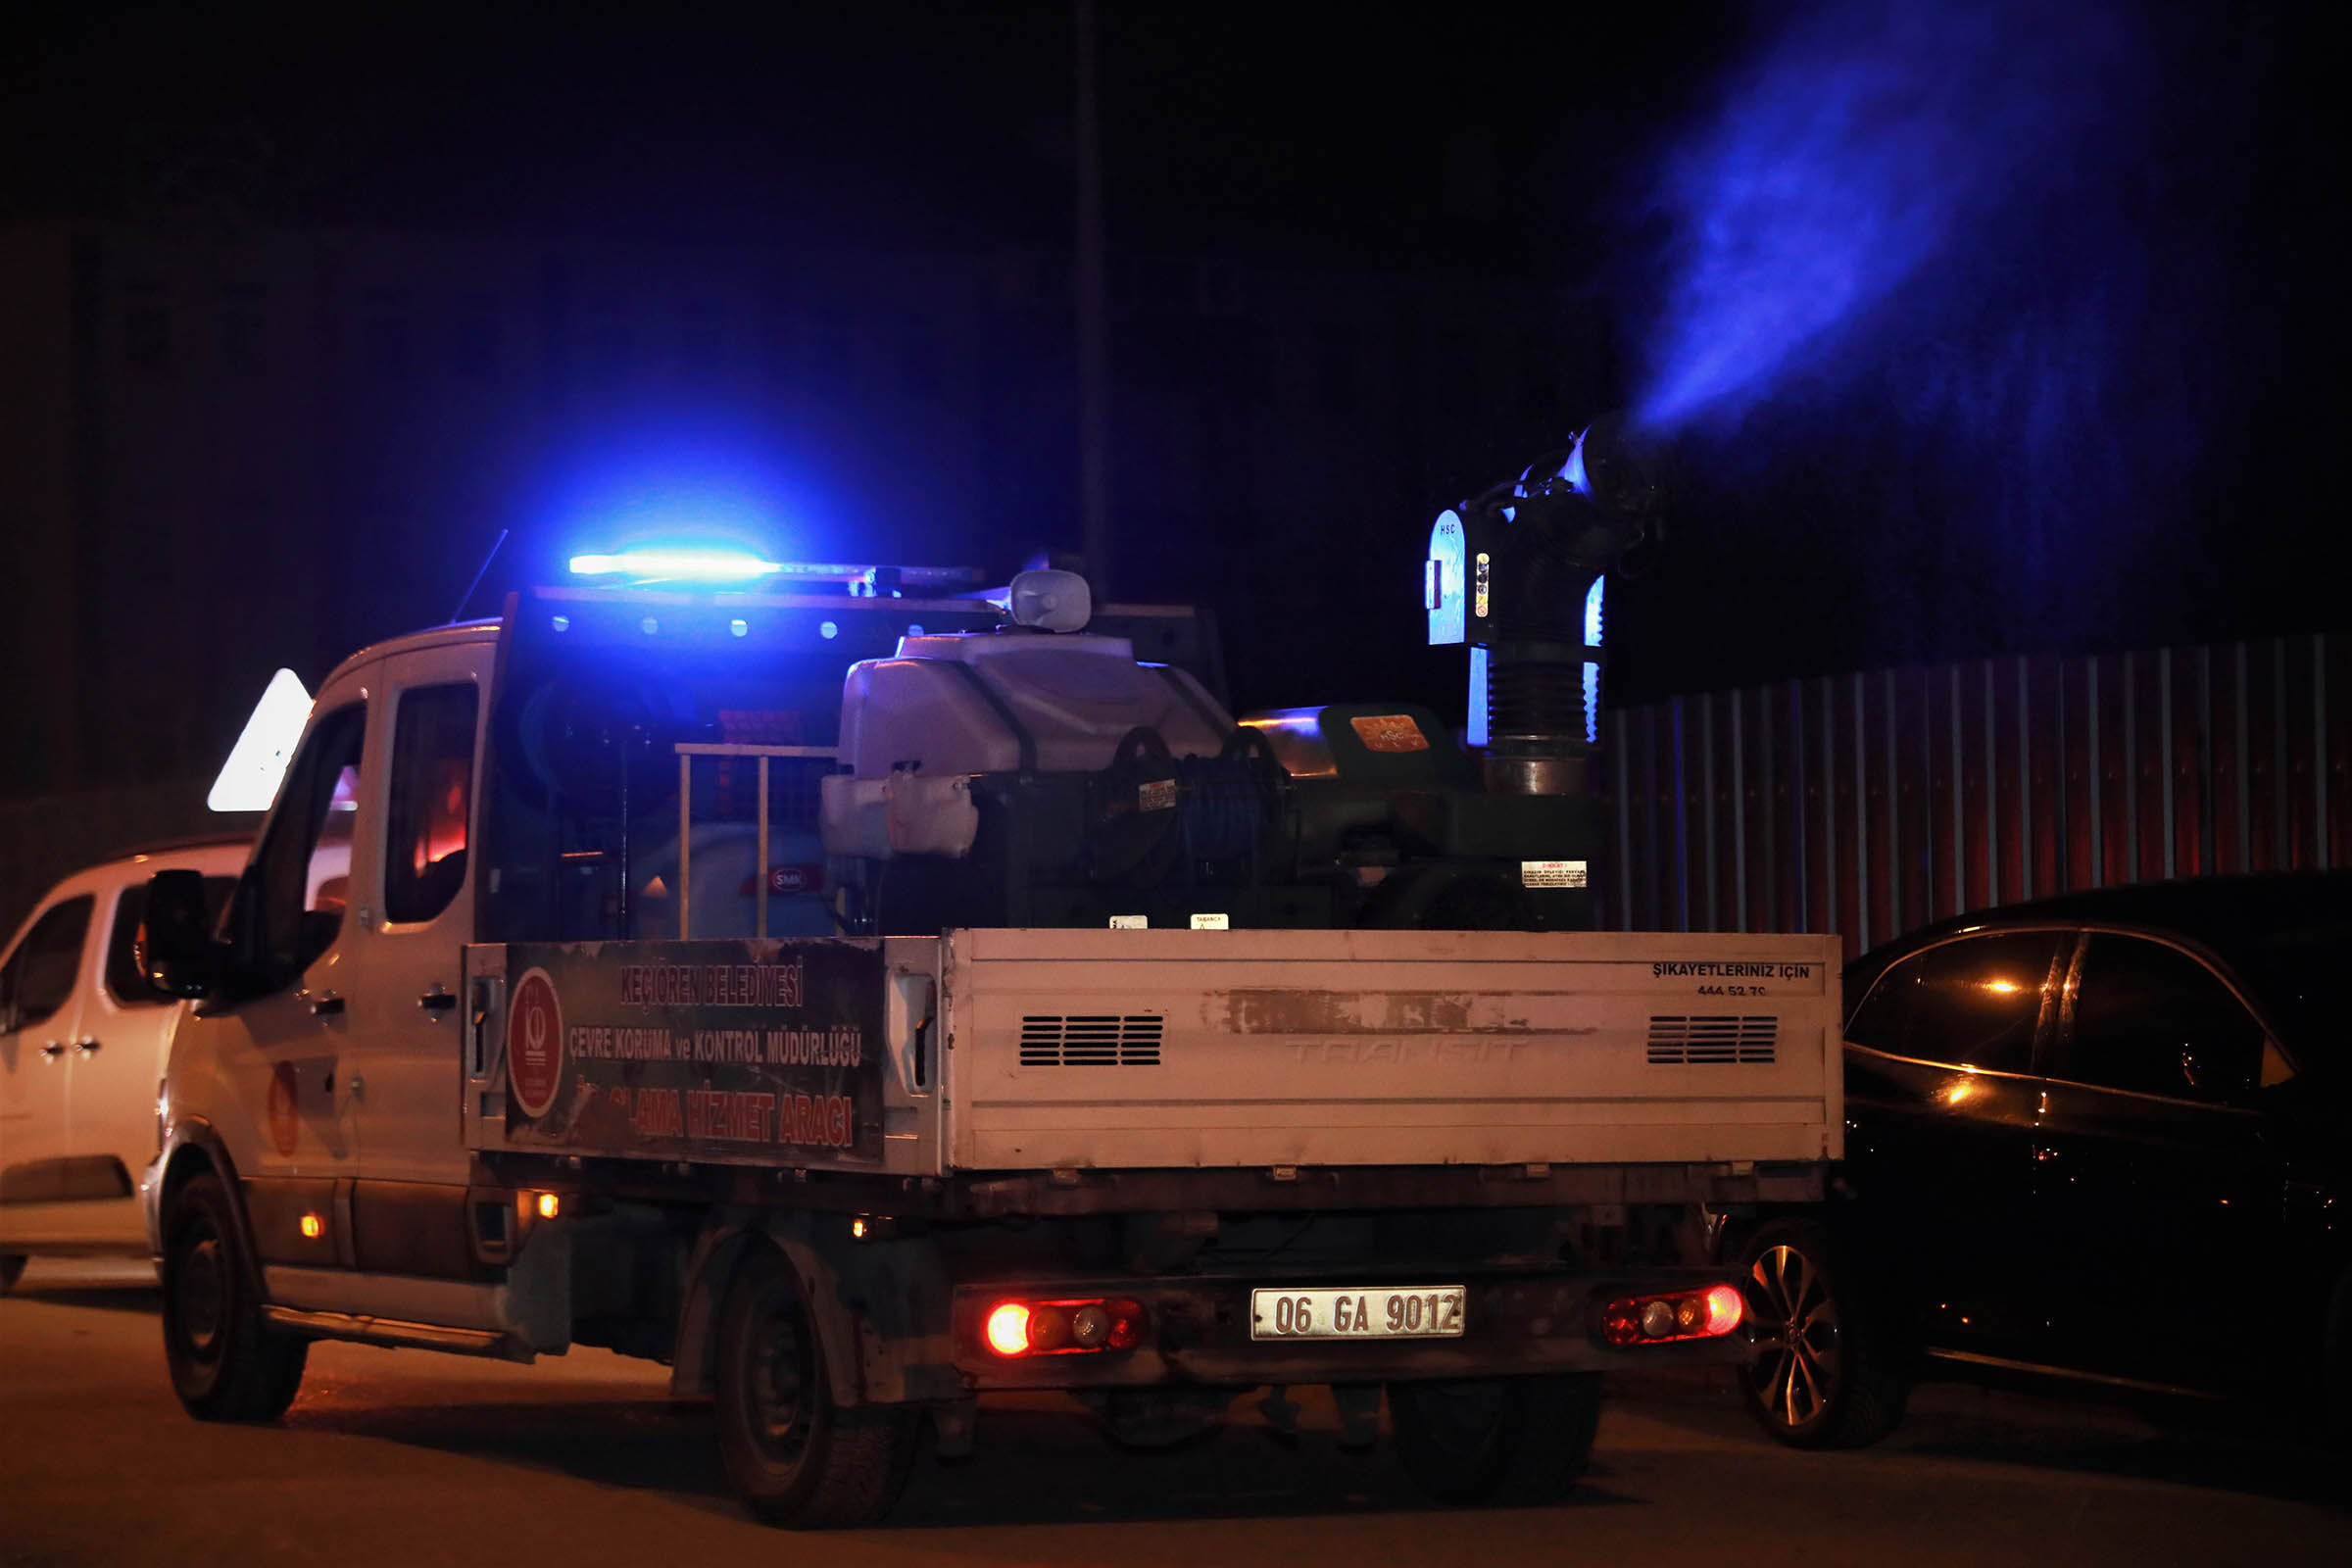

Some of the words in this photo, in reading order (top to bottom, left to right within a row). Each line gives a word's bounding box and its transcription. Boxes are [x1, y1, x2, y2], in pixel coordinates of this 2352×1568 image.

[1441, 524, 1455, 535] HSC
[1697, 985, 1724, 996] 444
[1728, 986, 1746, 997] 52
[570, 1026, 612, 1065] ÇEVRE
[614, 1028, 672, 1059] KORUMA
[675, 1038, 692, 1059] ve
[694, 1030, 763, 1063] KONTROL
[686, 1078, 776, 1144] HİZMET
[778, 1092, 854, 1148] ARACI
[1276, 1297, 1312, 1334] 06
[1334, 1296, 1369, 1333] GA
[1386, 1294, 1461, 1331] 9012
